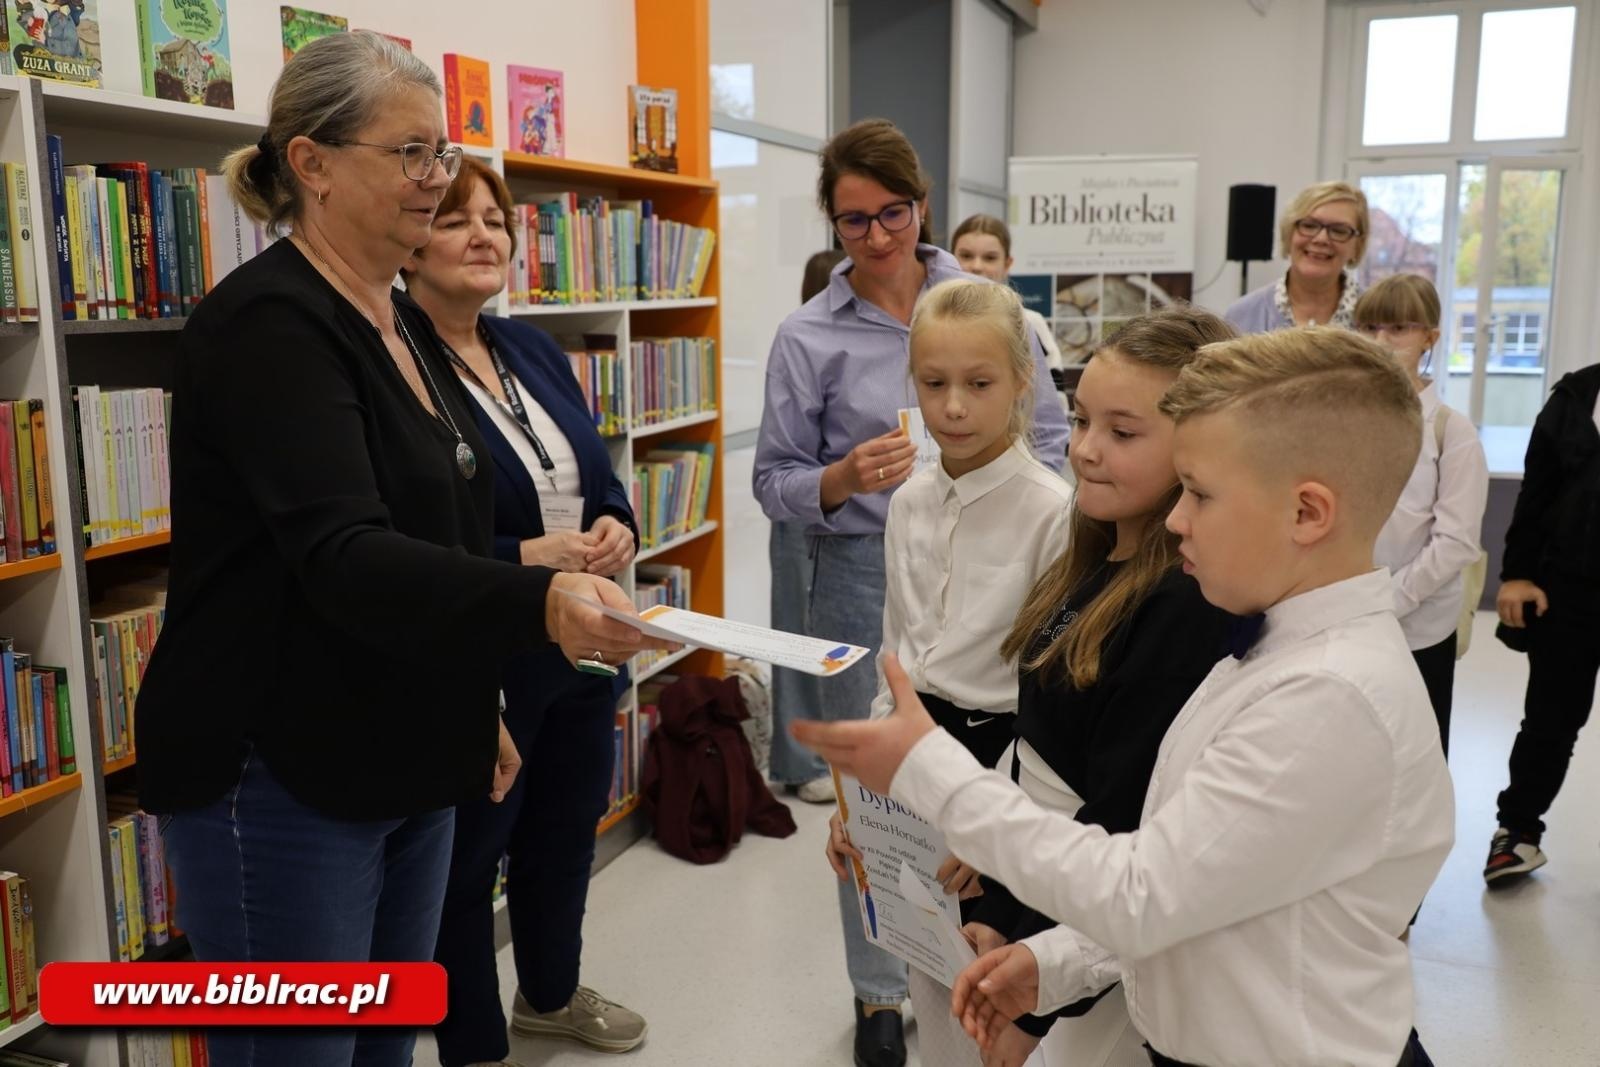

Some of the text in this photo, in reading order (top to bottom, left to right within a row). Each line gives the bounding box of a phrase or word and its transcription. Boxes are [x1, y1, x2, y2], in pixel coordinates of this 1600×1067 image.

[22, 56, 92, 77] ZUZA GRANT
[18, 169, 27, 201] ALCATRAZ
[1029, 192, 1176, 225] Biblioteka
[1086, 226, 1166, 246] Publiczna
[0, 248, 15, 308] SANDERSON
[858, 785, 928, 825] Dyplo
[859, 815, 889, 832] Elena
